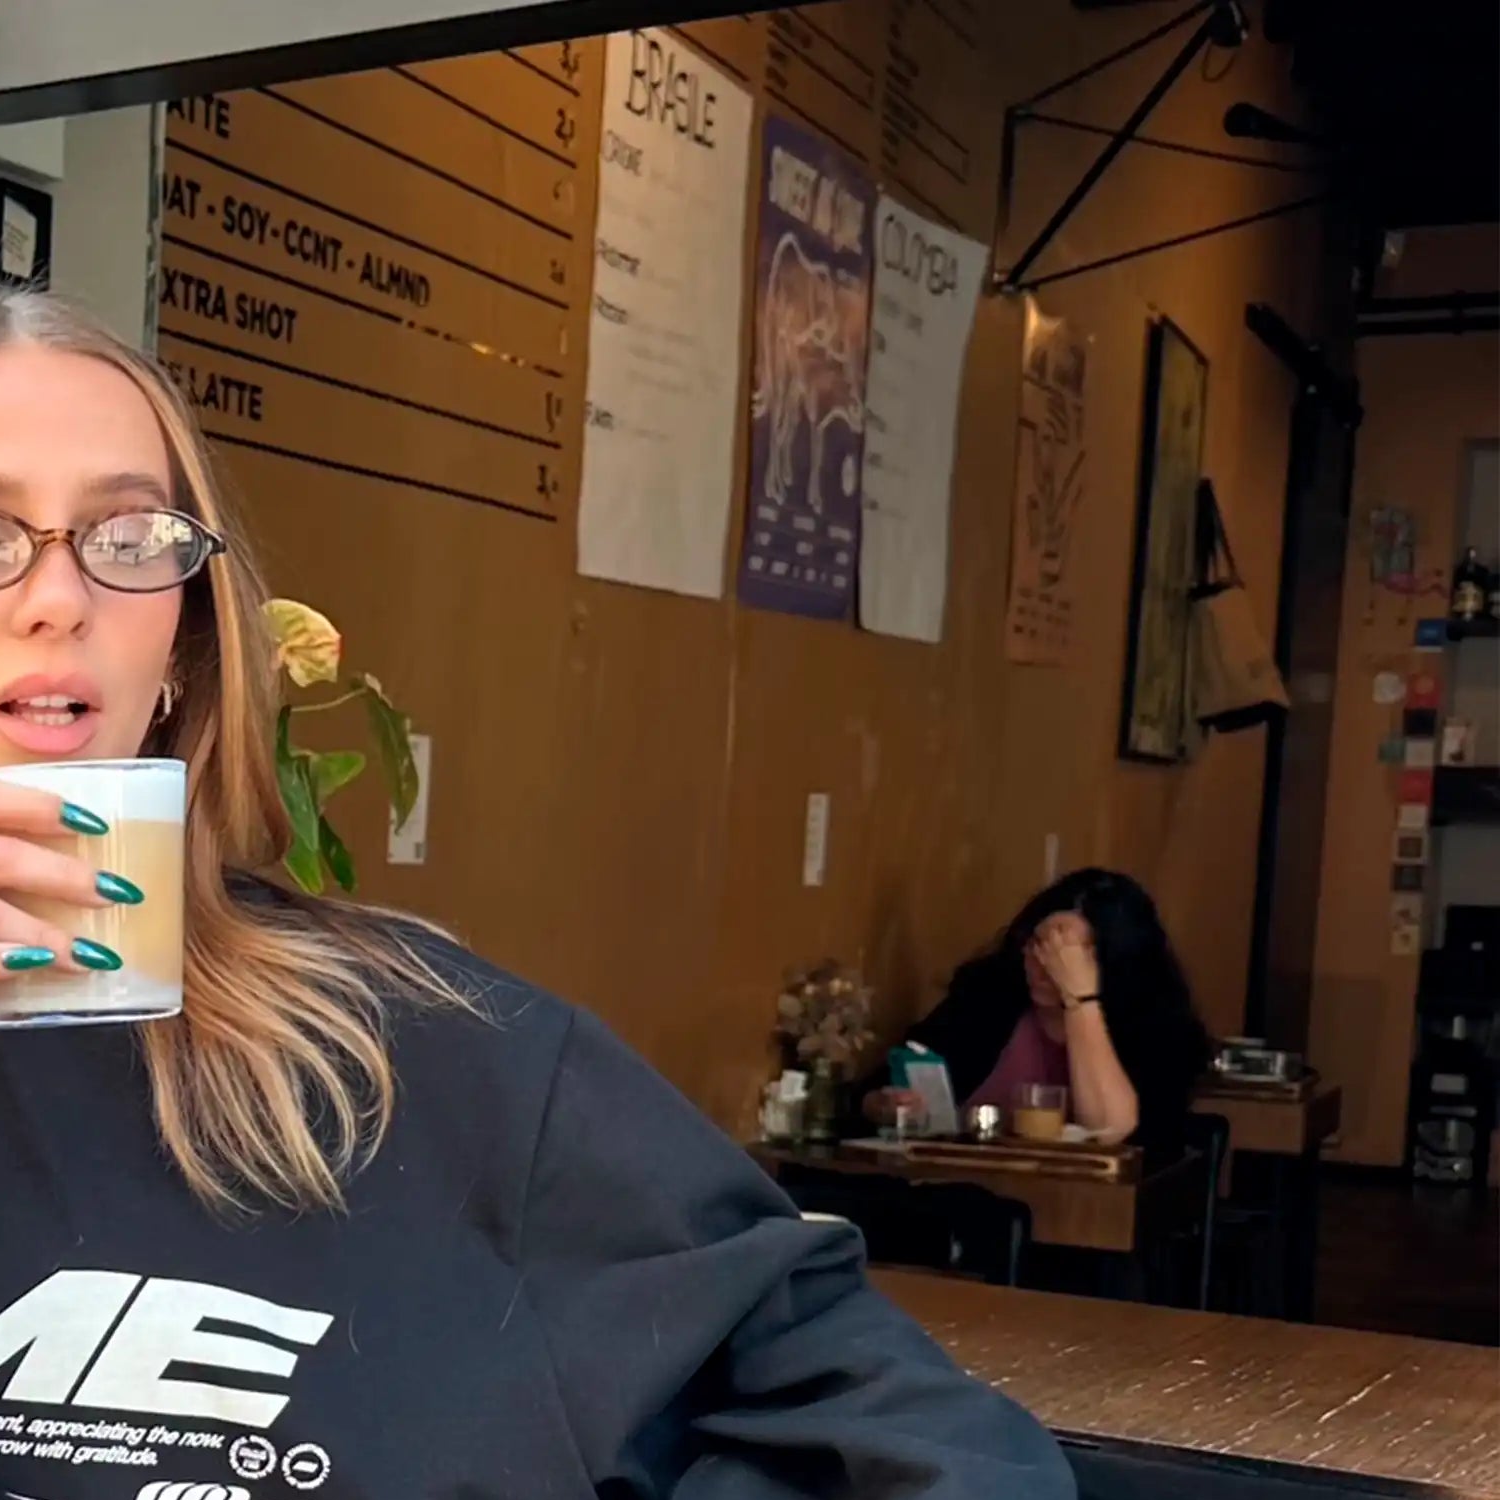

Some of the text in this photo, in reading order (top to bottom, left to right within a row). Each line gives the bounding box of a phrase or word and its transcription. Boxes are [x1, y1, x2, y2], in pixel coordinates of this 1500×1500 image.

[625, 29, 717, 148] BRASILE
[235, 292, 297, 344] SHOT
[26, 1419, 147, 1446] appreciating
[146, 1425, 180, 1445] the
[33, 1440, 74, 1460] with
